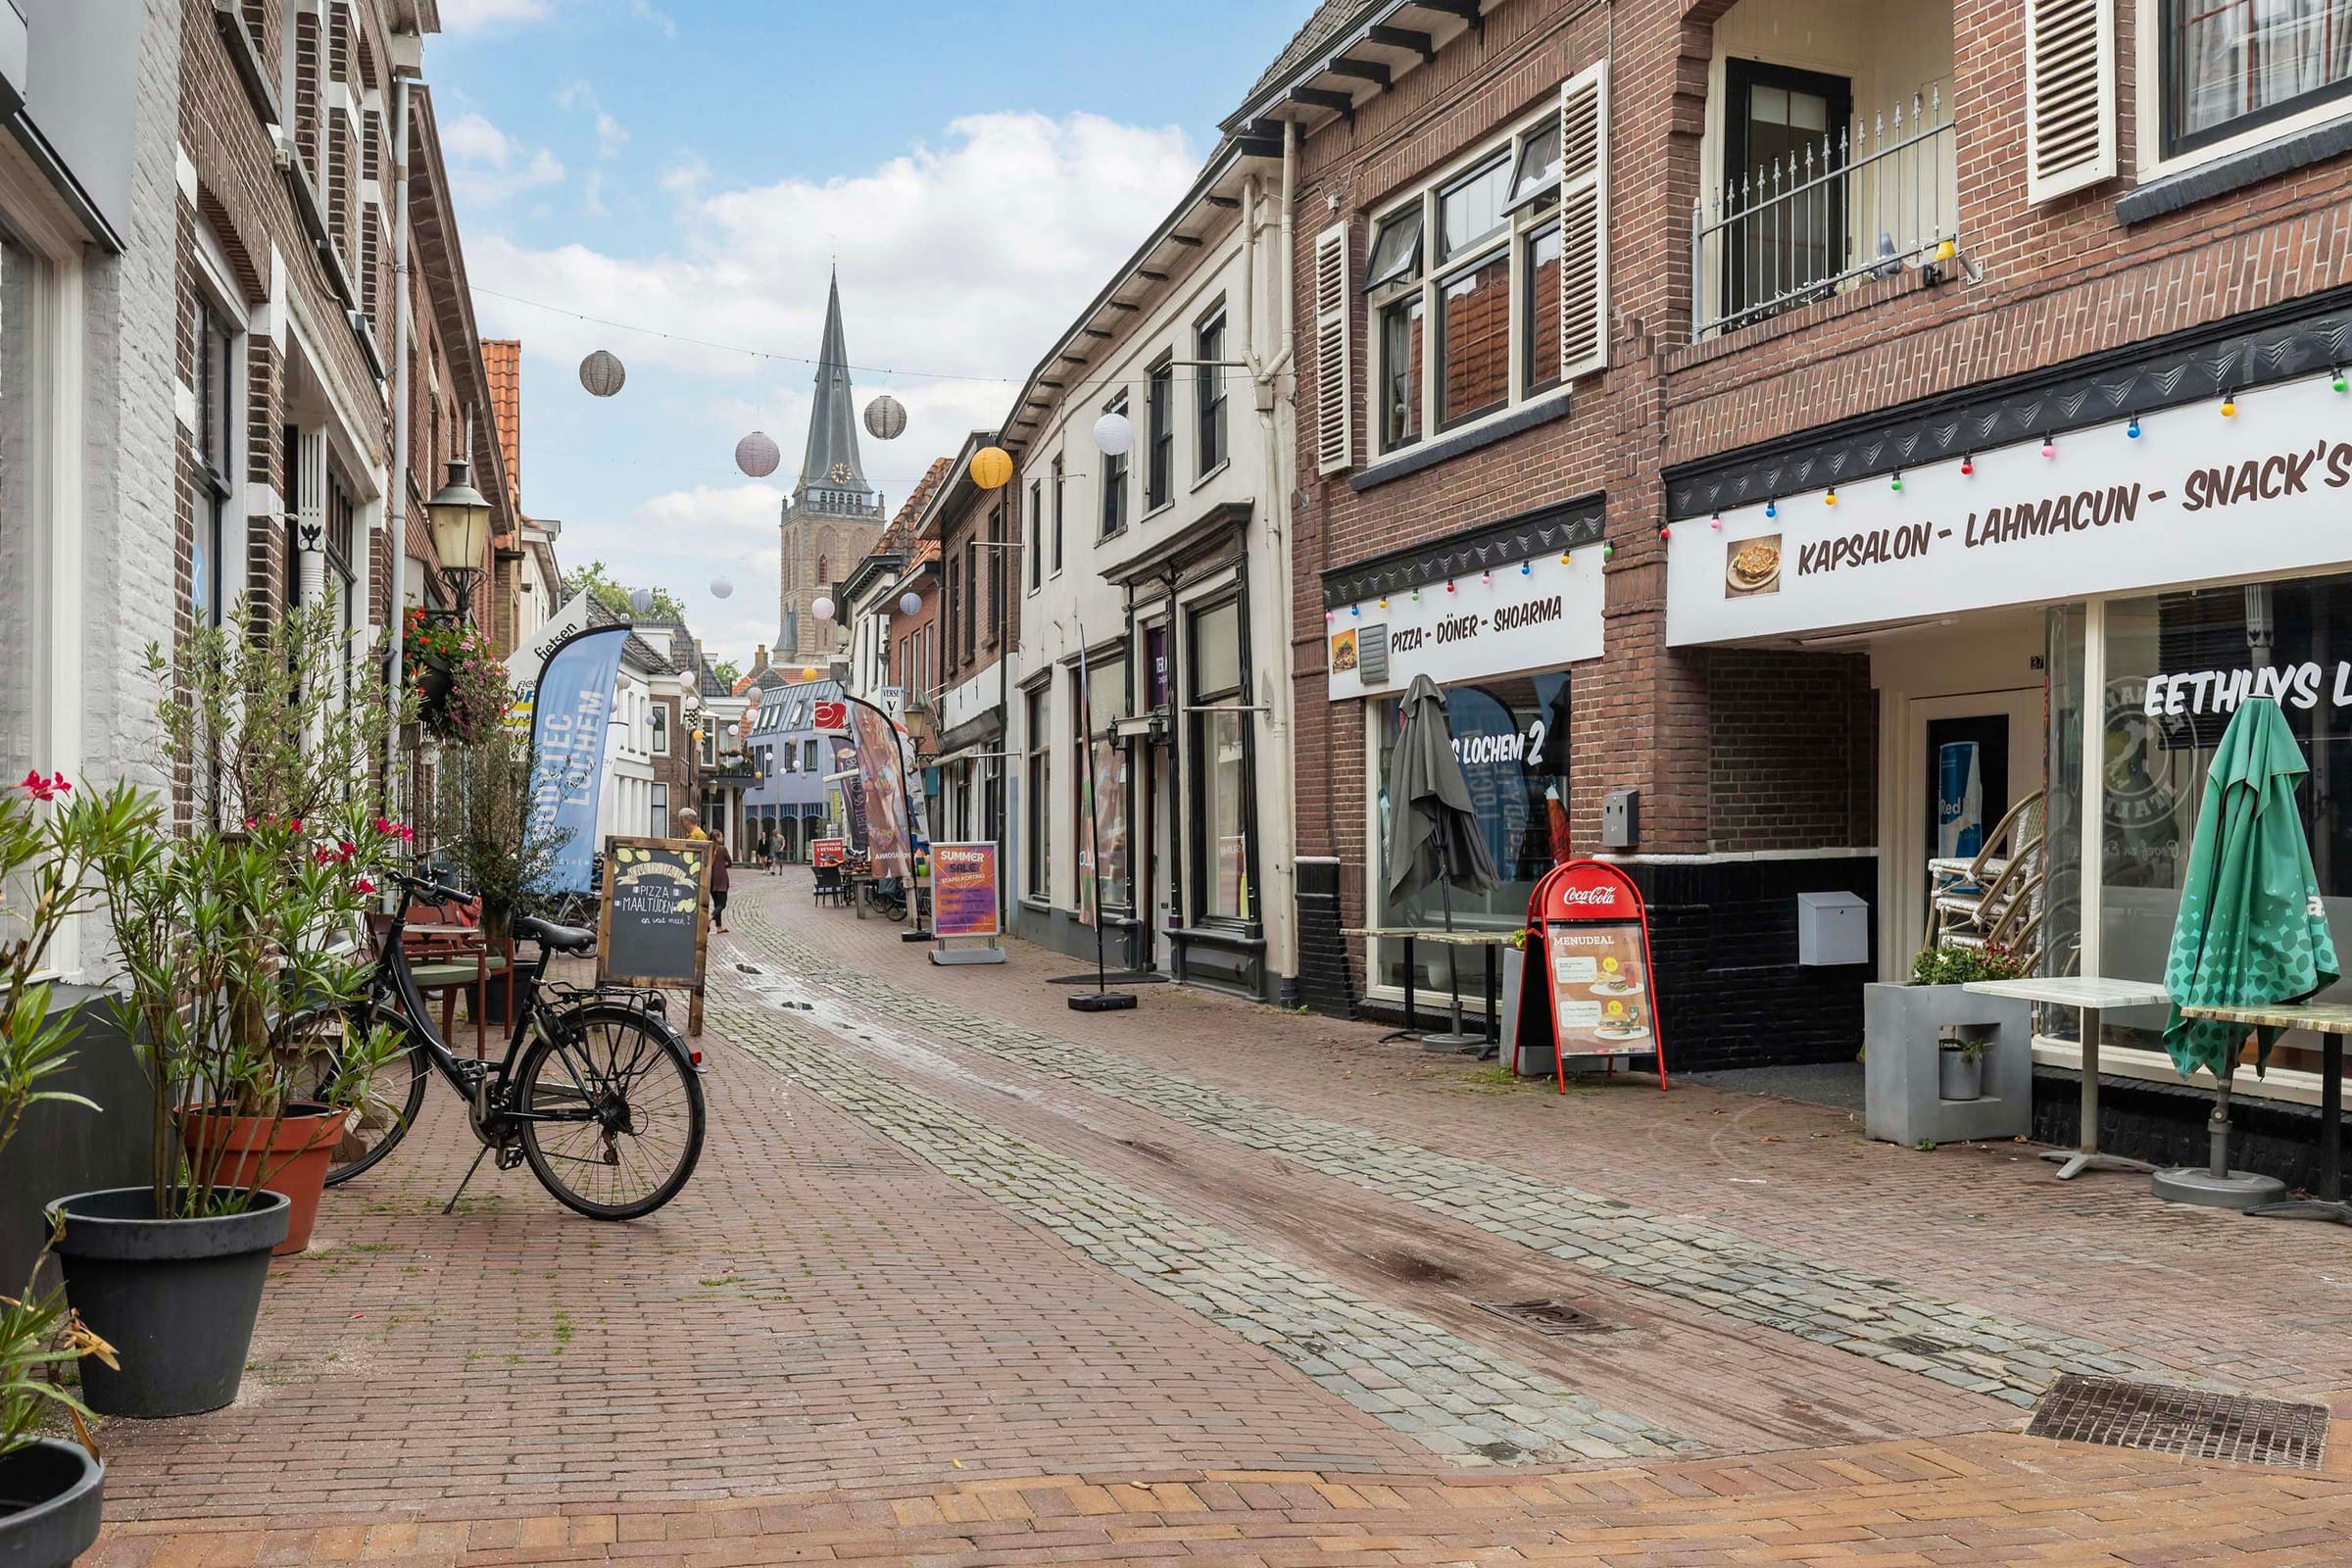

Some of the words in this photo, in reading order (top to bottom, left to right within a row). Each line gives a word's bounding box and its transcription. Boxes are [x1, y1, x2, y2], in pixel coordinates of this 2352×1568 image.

[1797, 520, 1932, 576] KAPSALON
[1965, 482, 2141, 549] LAHMACUN
[2181, 439, 2352, 512] SNACK'S
[1391, 626, 1422, 654] PIZZA
[1437, 612, 1478, 644] DÖNER
[1494, 595, 1562, 632] SHOARMA
[534, 622, 577, 661] fietsen
[2031, 657, 2043, 669] 37
[564, 690, 605, 806] LOCHEM
[1463, 732, 1525, 764] LOCHEM
[1527, 720, 1545, 766] 2
[940, 851, 985, 862] SUMMER
[950, 863, 977, 873] SALE
[640, 886, 669, 899] PIZZA
[622, 897, 674, 914] MAALTIJDEN
[1553, 936, 1615, 947] MENUDEAL
